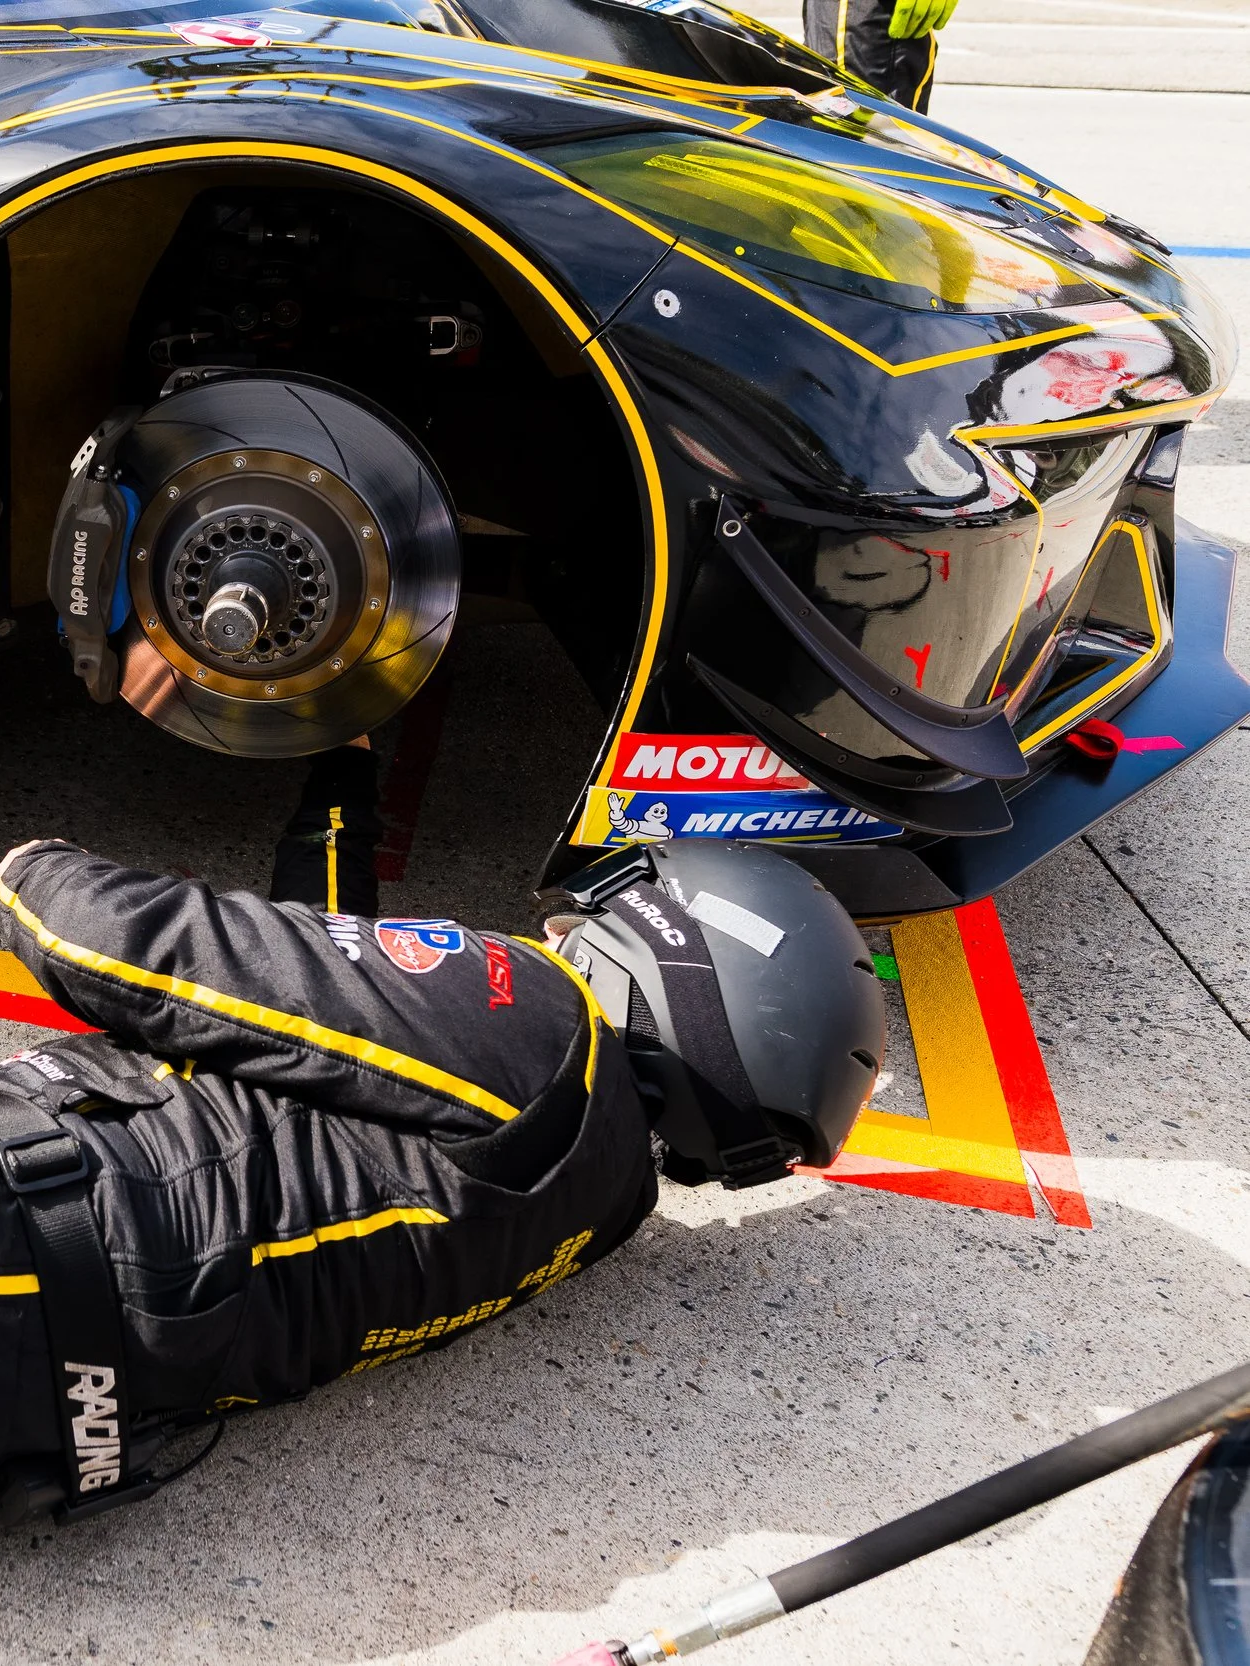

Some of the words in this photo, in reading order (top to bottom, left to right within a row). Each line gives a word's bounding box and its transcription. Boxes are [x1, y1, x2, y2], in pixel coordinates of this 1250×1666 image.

[71, 530, 88, 586] RACING
[70, 587, 89, 616] AP
[64, 1361, 121, 1493] RACING
